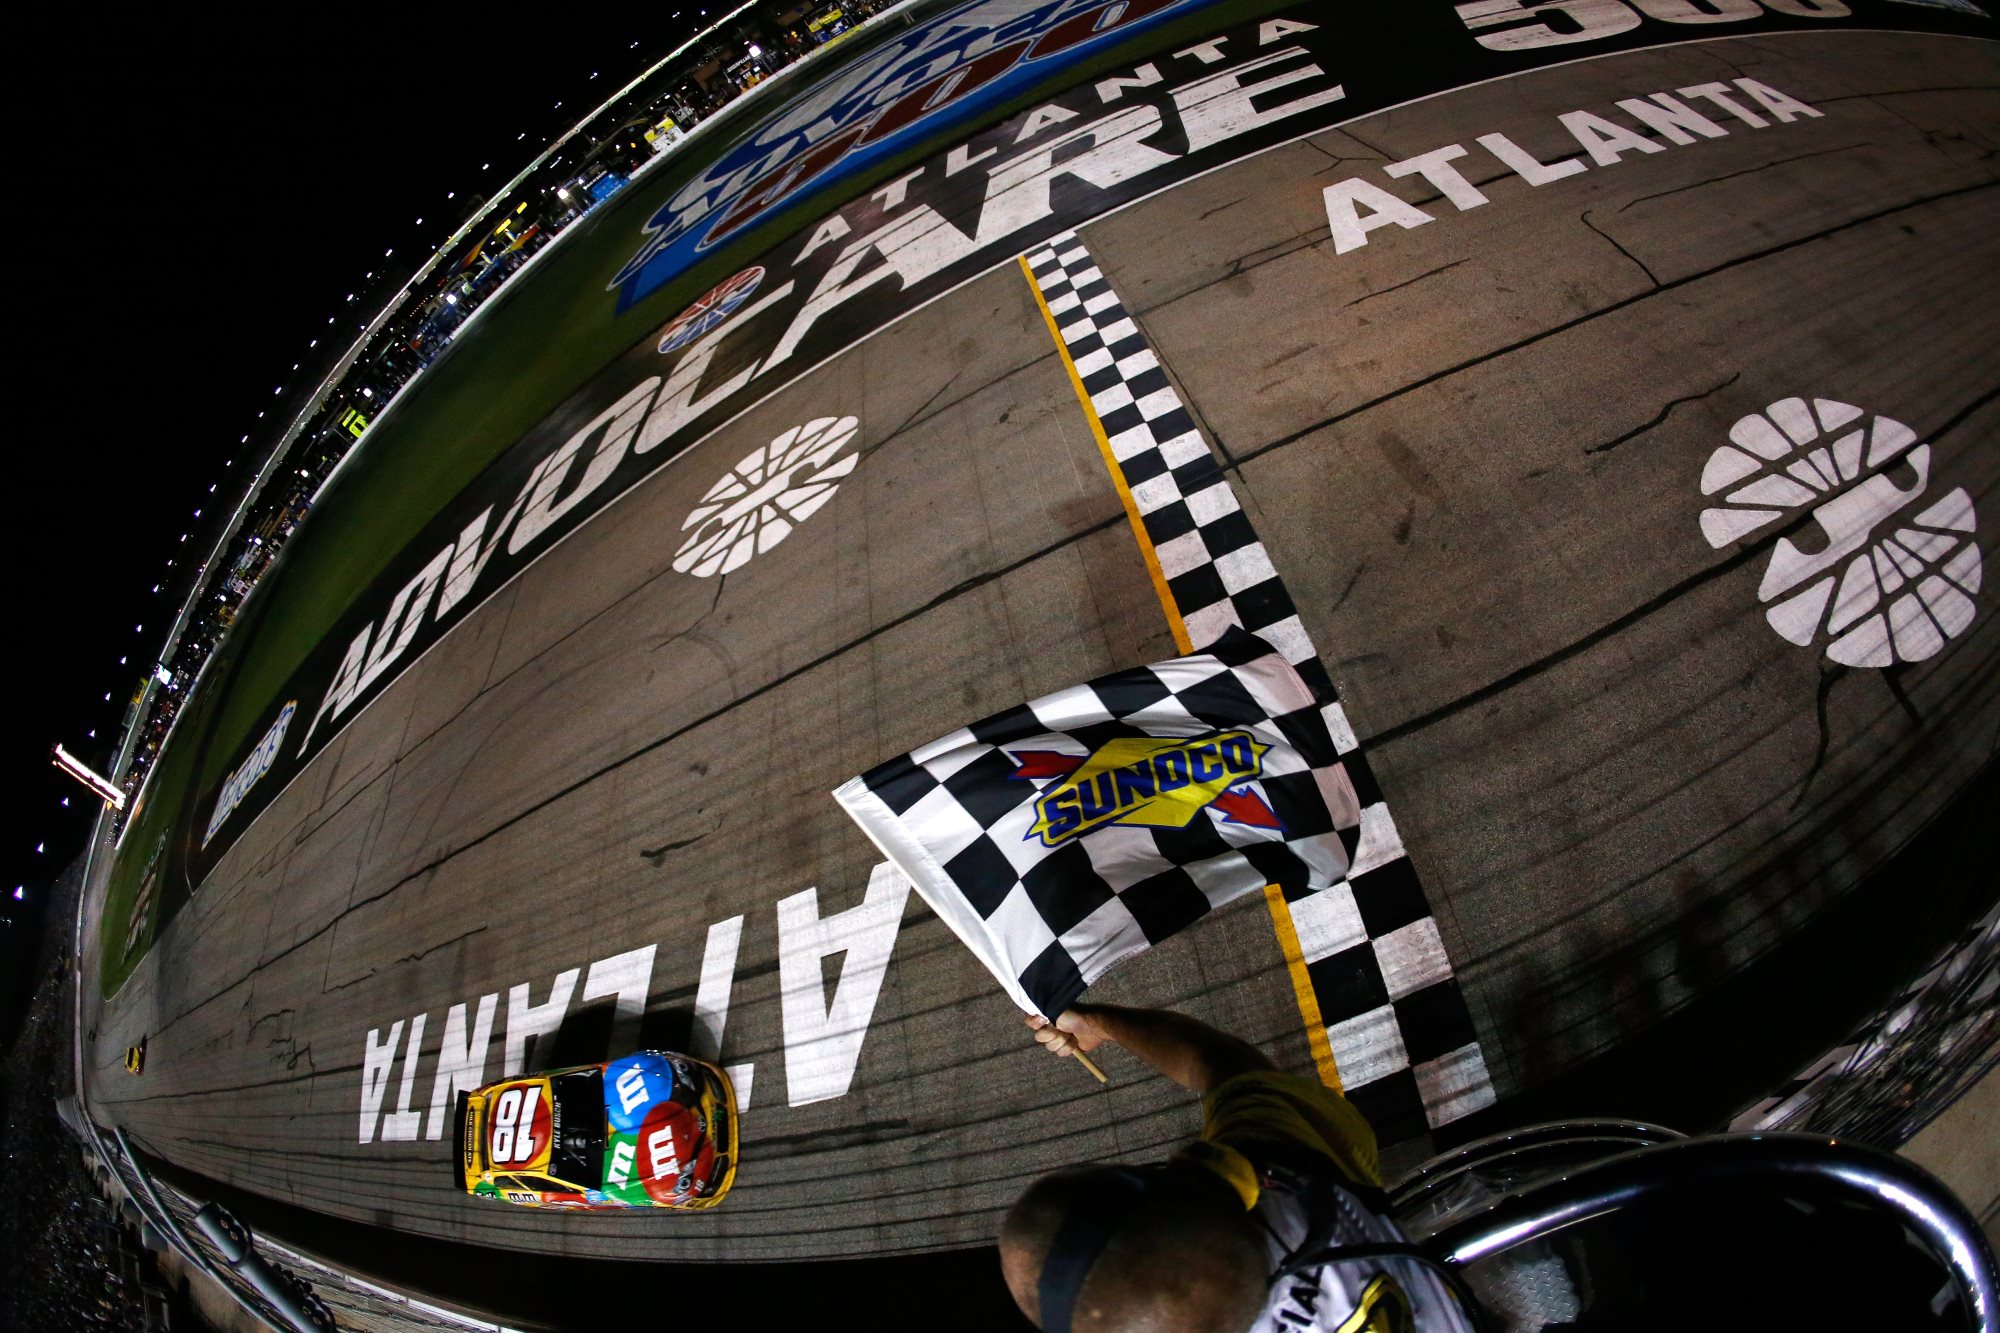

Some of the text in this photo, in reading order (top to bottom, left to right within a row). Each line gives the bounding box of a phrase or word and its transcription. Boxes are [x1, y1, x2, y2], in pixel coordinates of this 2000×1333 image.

[791, 18, 1320, 267] ATLANTA
[1321, 77, 1825, 255] ATLANTA
[295, 46, 1346, 760] ADVOCARE
[1043, 735, 1255, 840] SUNOCO
[358, 860, 912, 1144] ATLANTA
[492, 1086, 542, 1164] 18
[553, 1102, 562, 1149] KYLE BUSCH
